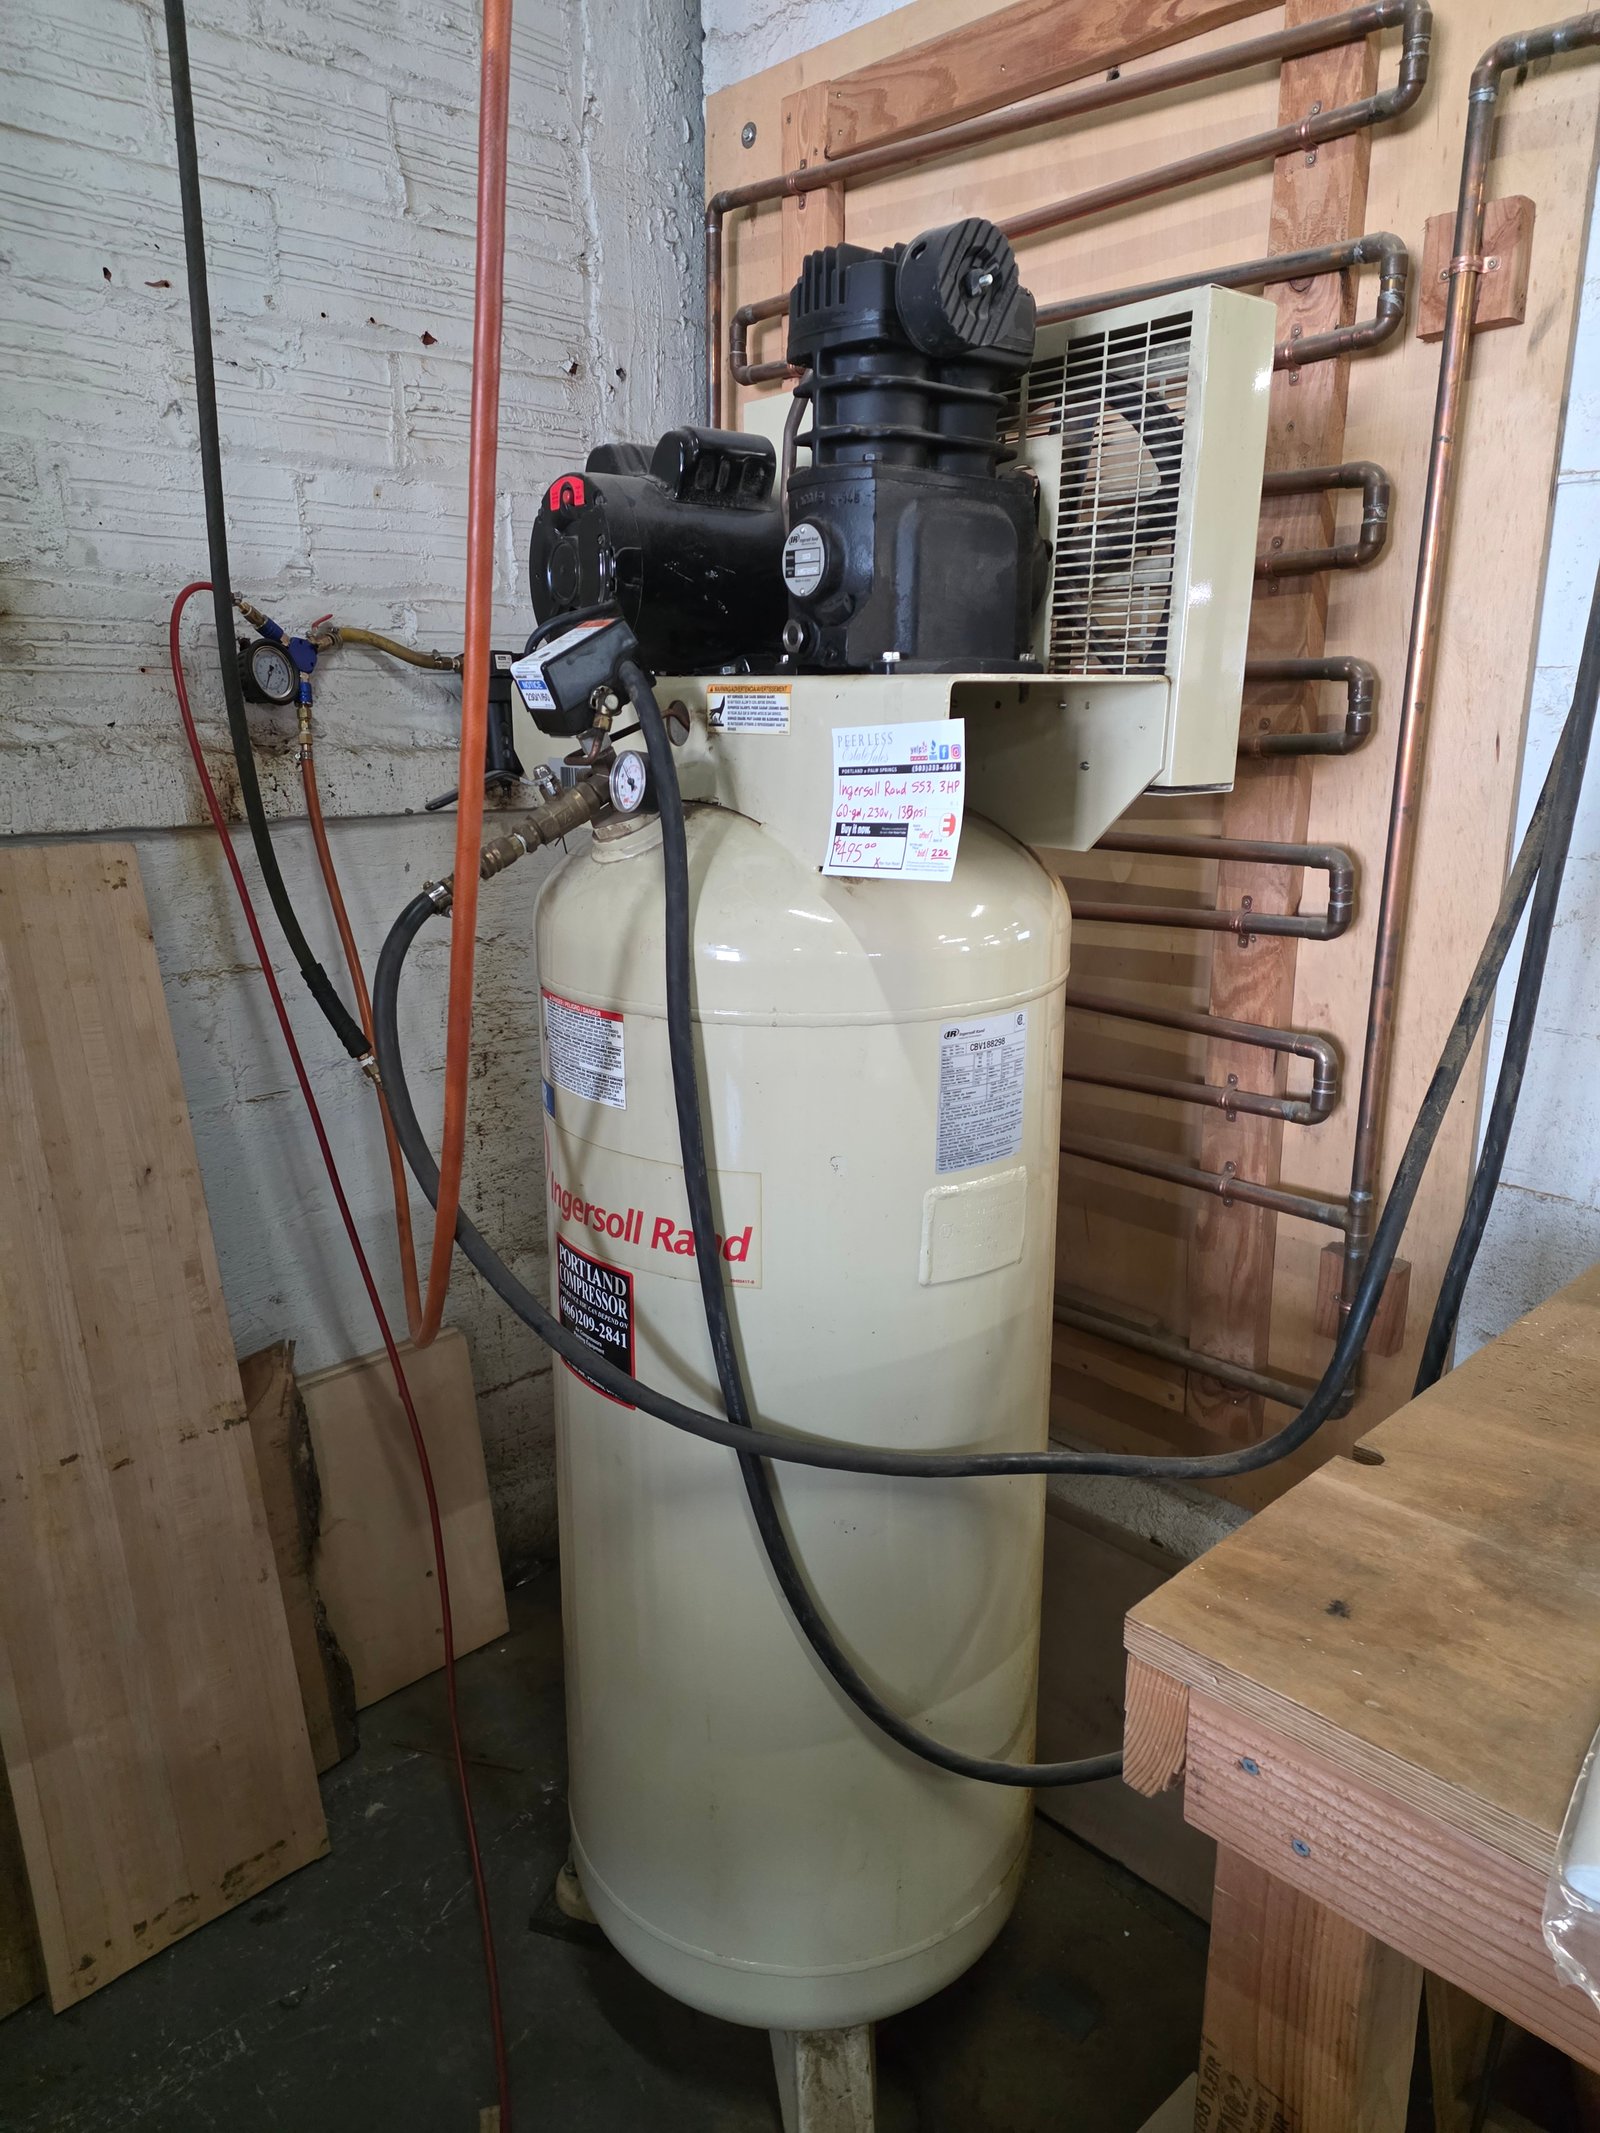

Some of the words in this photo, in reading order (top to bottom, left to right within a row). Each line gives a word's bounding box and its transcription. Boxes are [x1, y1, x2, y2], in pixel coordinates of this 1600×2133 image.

[521, 681, 544, 689] NOTICE
[837, 731, 893, 748] PEERLESS
[839, 779, 880, 801] Ingersoll
[841, 824, 852, 837] Buy
[852, 824, 858, 834] it
[565, 1001, 580, 1011] PELIGRO
[583, 1007, 601, 1016] DANGER
[970, 1037, 1006, 1051] CBV188298
[551, 1171, 644, 1245] Ingersoll
[651, 1216, 753, 1262] Rad
[559, 1243, 627, 1297] PORTLAND
[559, 1262, 628, 1320] COMPRESSOR
[560, 1294, 627, 1349] (866)209-2841
[588, 1306, 598, 1316] CAN
[598, 1311, 619, 1326] DEPEND
[619, 1321, 628, 1329] ON
